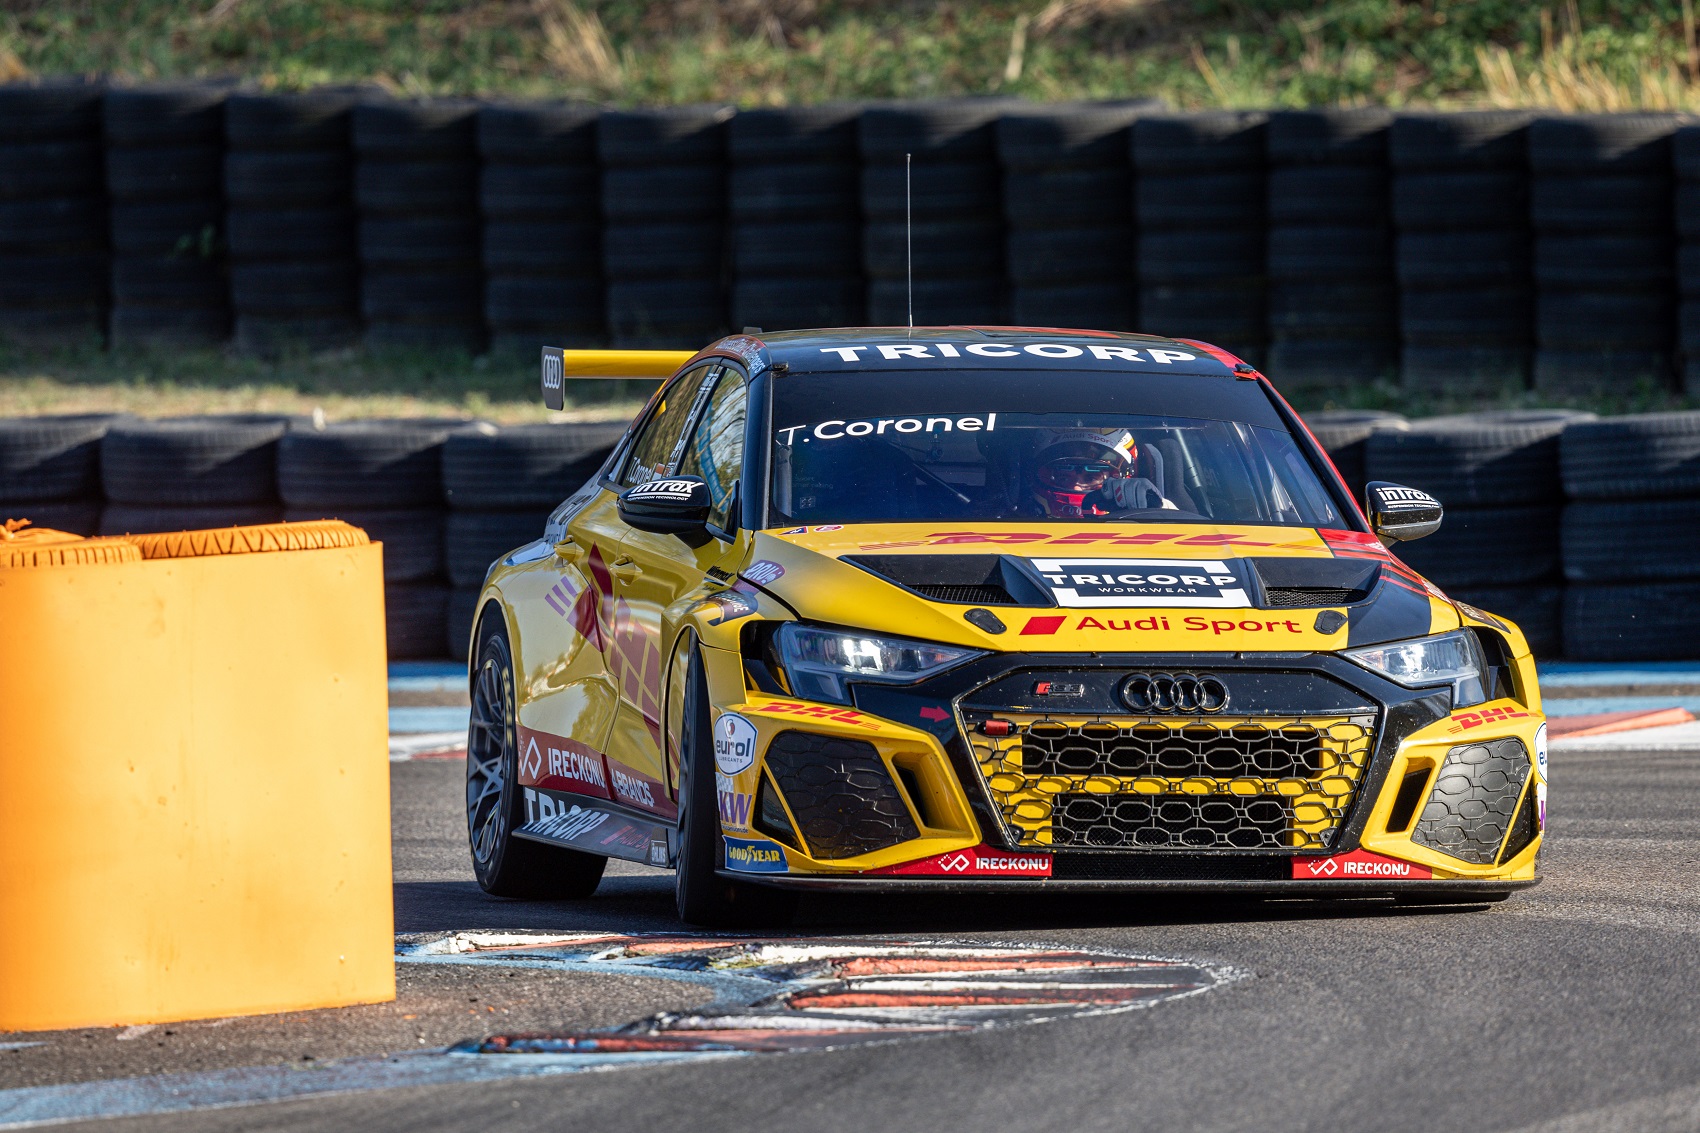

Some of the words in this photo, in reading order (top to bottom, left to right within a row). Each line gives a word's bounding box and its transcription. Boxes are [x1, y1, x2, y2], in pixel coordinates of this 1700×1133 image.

[819, 343, 1197, 365] TRICORP
[778, 412, 998, 446] T.Coronel
[1062, 432, 1085, 440] Audi
[1087, 433, 1114, 447] Sport
[925, 531, 1279, 547] DHL
[1042, 574, 1237, 587] TRICORP
[1098, 587, 1198, 595] WORKWEAR
[1075, 616, 1168, 631] Audi
[1183, 616, 1302, 635] Sport
[758, 702, 866, 725] DHL
[1450, 706, 1529, 730] DHL
[716, 738, 751, 757] eurol
[547, 747, 605, 788] IRECKONU
[719, 790, 752, 825] KW
[728, 845, 781, 865] GOODYEAR
[976, 857, 1049, 870] IRECKONU
[1343, 861, 1410, 876] IRECKONU
